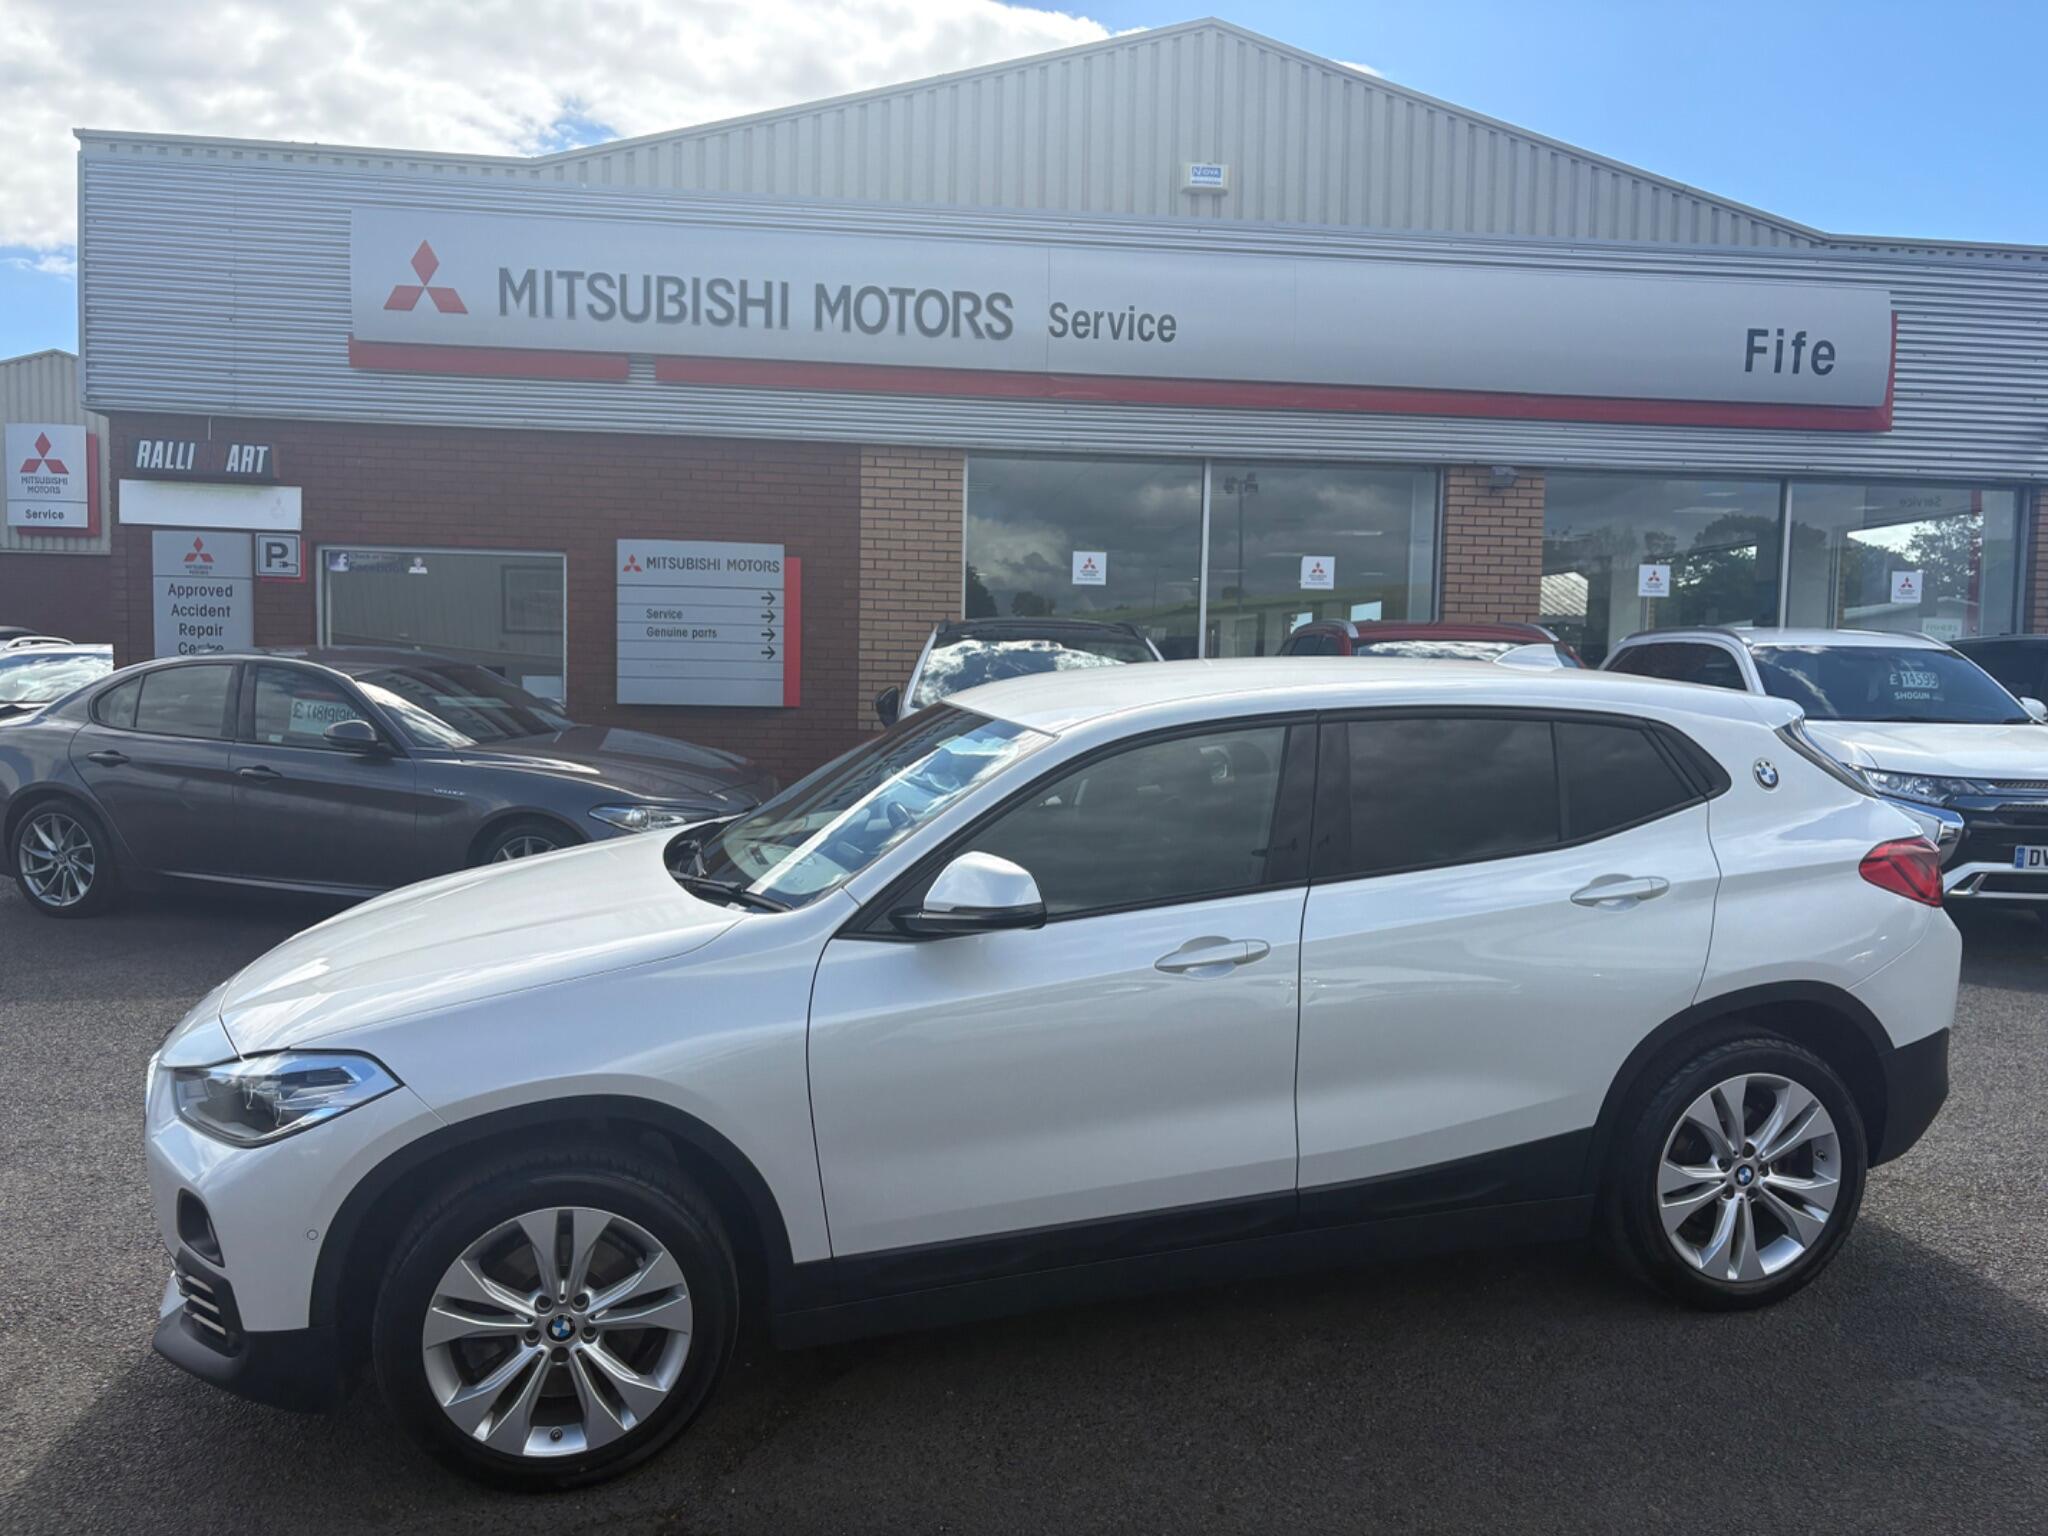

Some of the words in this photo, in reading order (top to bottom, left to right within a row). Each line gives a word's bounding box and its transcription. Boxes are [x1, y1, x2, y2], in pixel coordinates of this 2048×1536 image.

[499, 266, 790, 330] MITSUBISHI
[814, 282, 1014, 341] MOTORS
[1048, 301, 1177, 343] Service
[1744, 328, 1836, 376] Fife
[136, 439, 196, 470] RALLI
[226, 444, 269, 473] ART
[27, 486, 61, 494] MOTORS
[25, 509, 65, 519] Service
[265, 542, 289, 568] P
[646, 556, 721, 571] MITSUBISHI
[727, 559, 780, 573] MOTORS
[168, 583, 233, 599] Approved
[171, 603, 231, 617] Accident
[646, 608, 683, 620] Service
[179, 622, 223, 639] Repair
[646, 626, 688, 638] Genuine
[692, 628, 717, 640] parts
